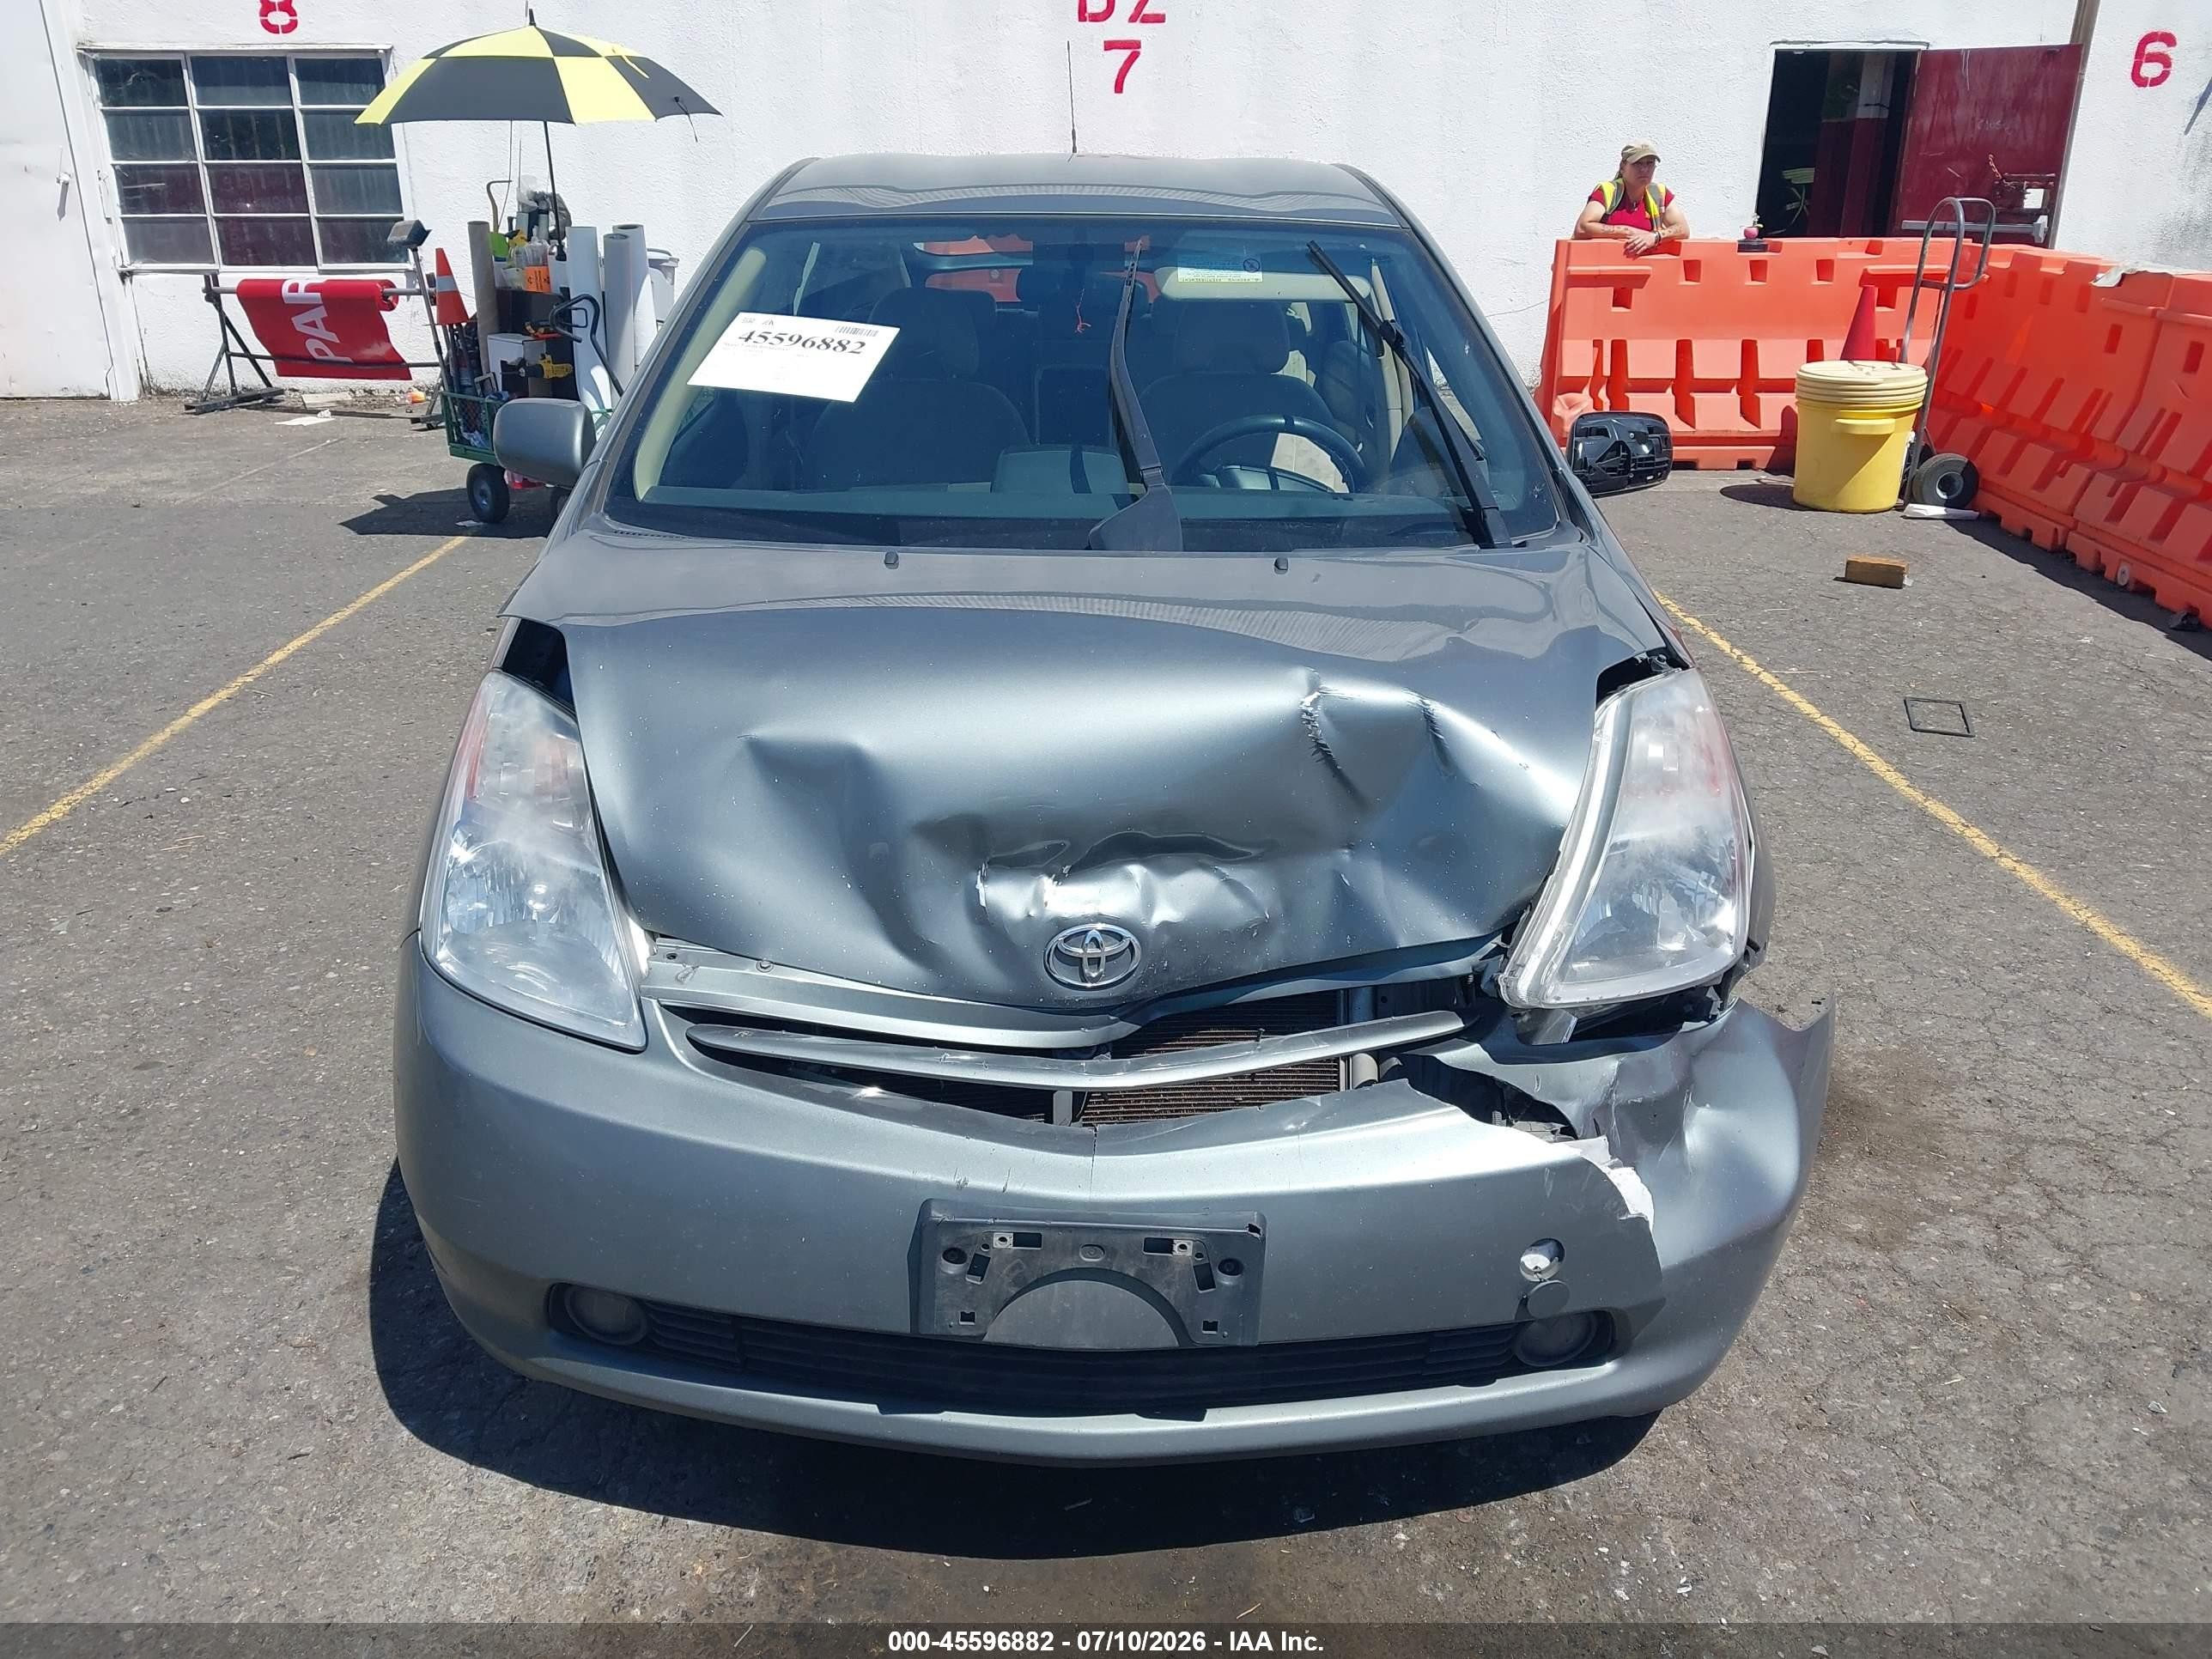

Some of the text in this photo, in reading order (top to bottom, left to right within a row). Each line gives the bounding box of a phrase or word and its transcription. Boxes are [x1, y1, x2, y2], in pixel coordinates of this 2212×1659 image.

[259, 0, 298, 34] 8
[1103, 40, 1141, 94] 7
[2131, 31, 2177, 88] 6
[738, 330, 866, 355] 45596882
